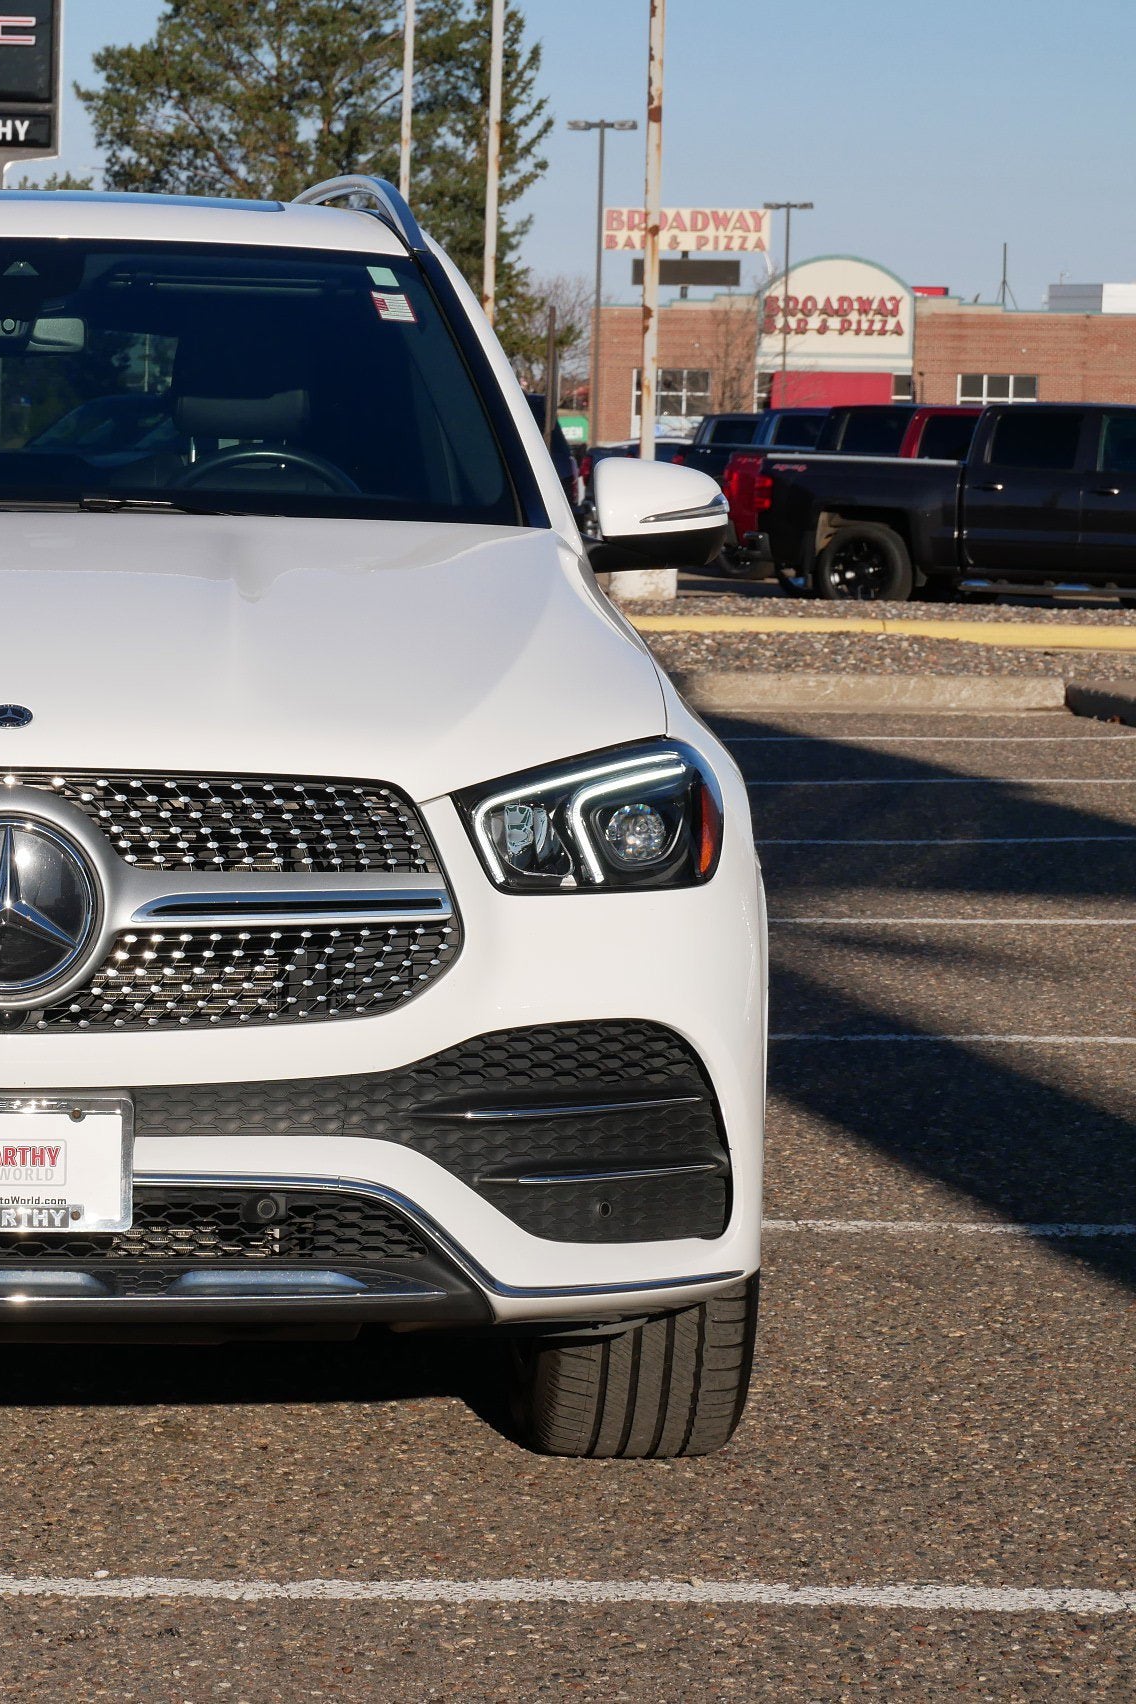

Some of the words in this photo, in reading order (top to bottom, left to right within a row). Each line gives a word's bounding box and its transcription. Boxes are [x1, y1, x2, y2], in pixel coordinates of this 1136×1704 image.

[667, 235, 681, 250] &
[696, 235, 766, 252] PIZZA
[764, 295, 904, 318] BROADWAY
[763, 318, 809, 335] BAR
[817, 318, 830, 335] &
[839, 318, 904, 336] PIZZA
